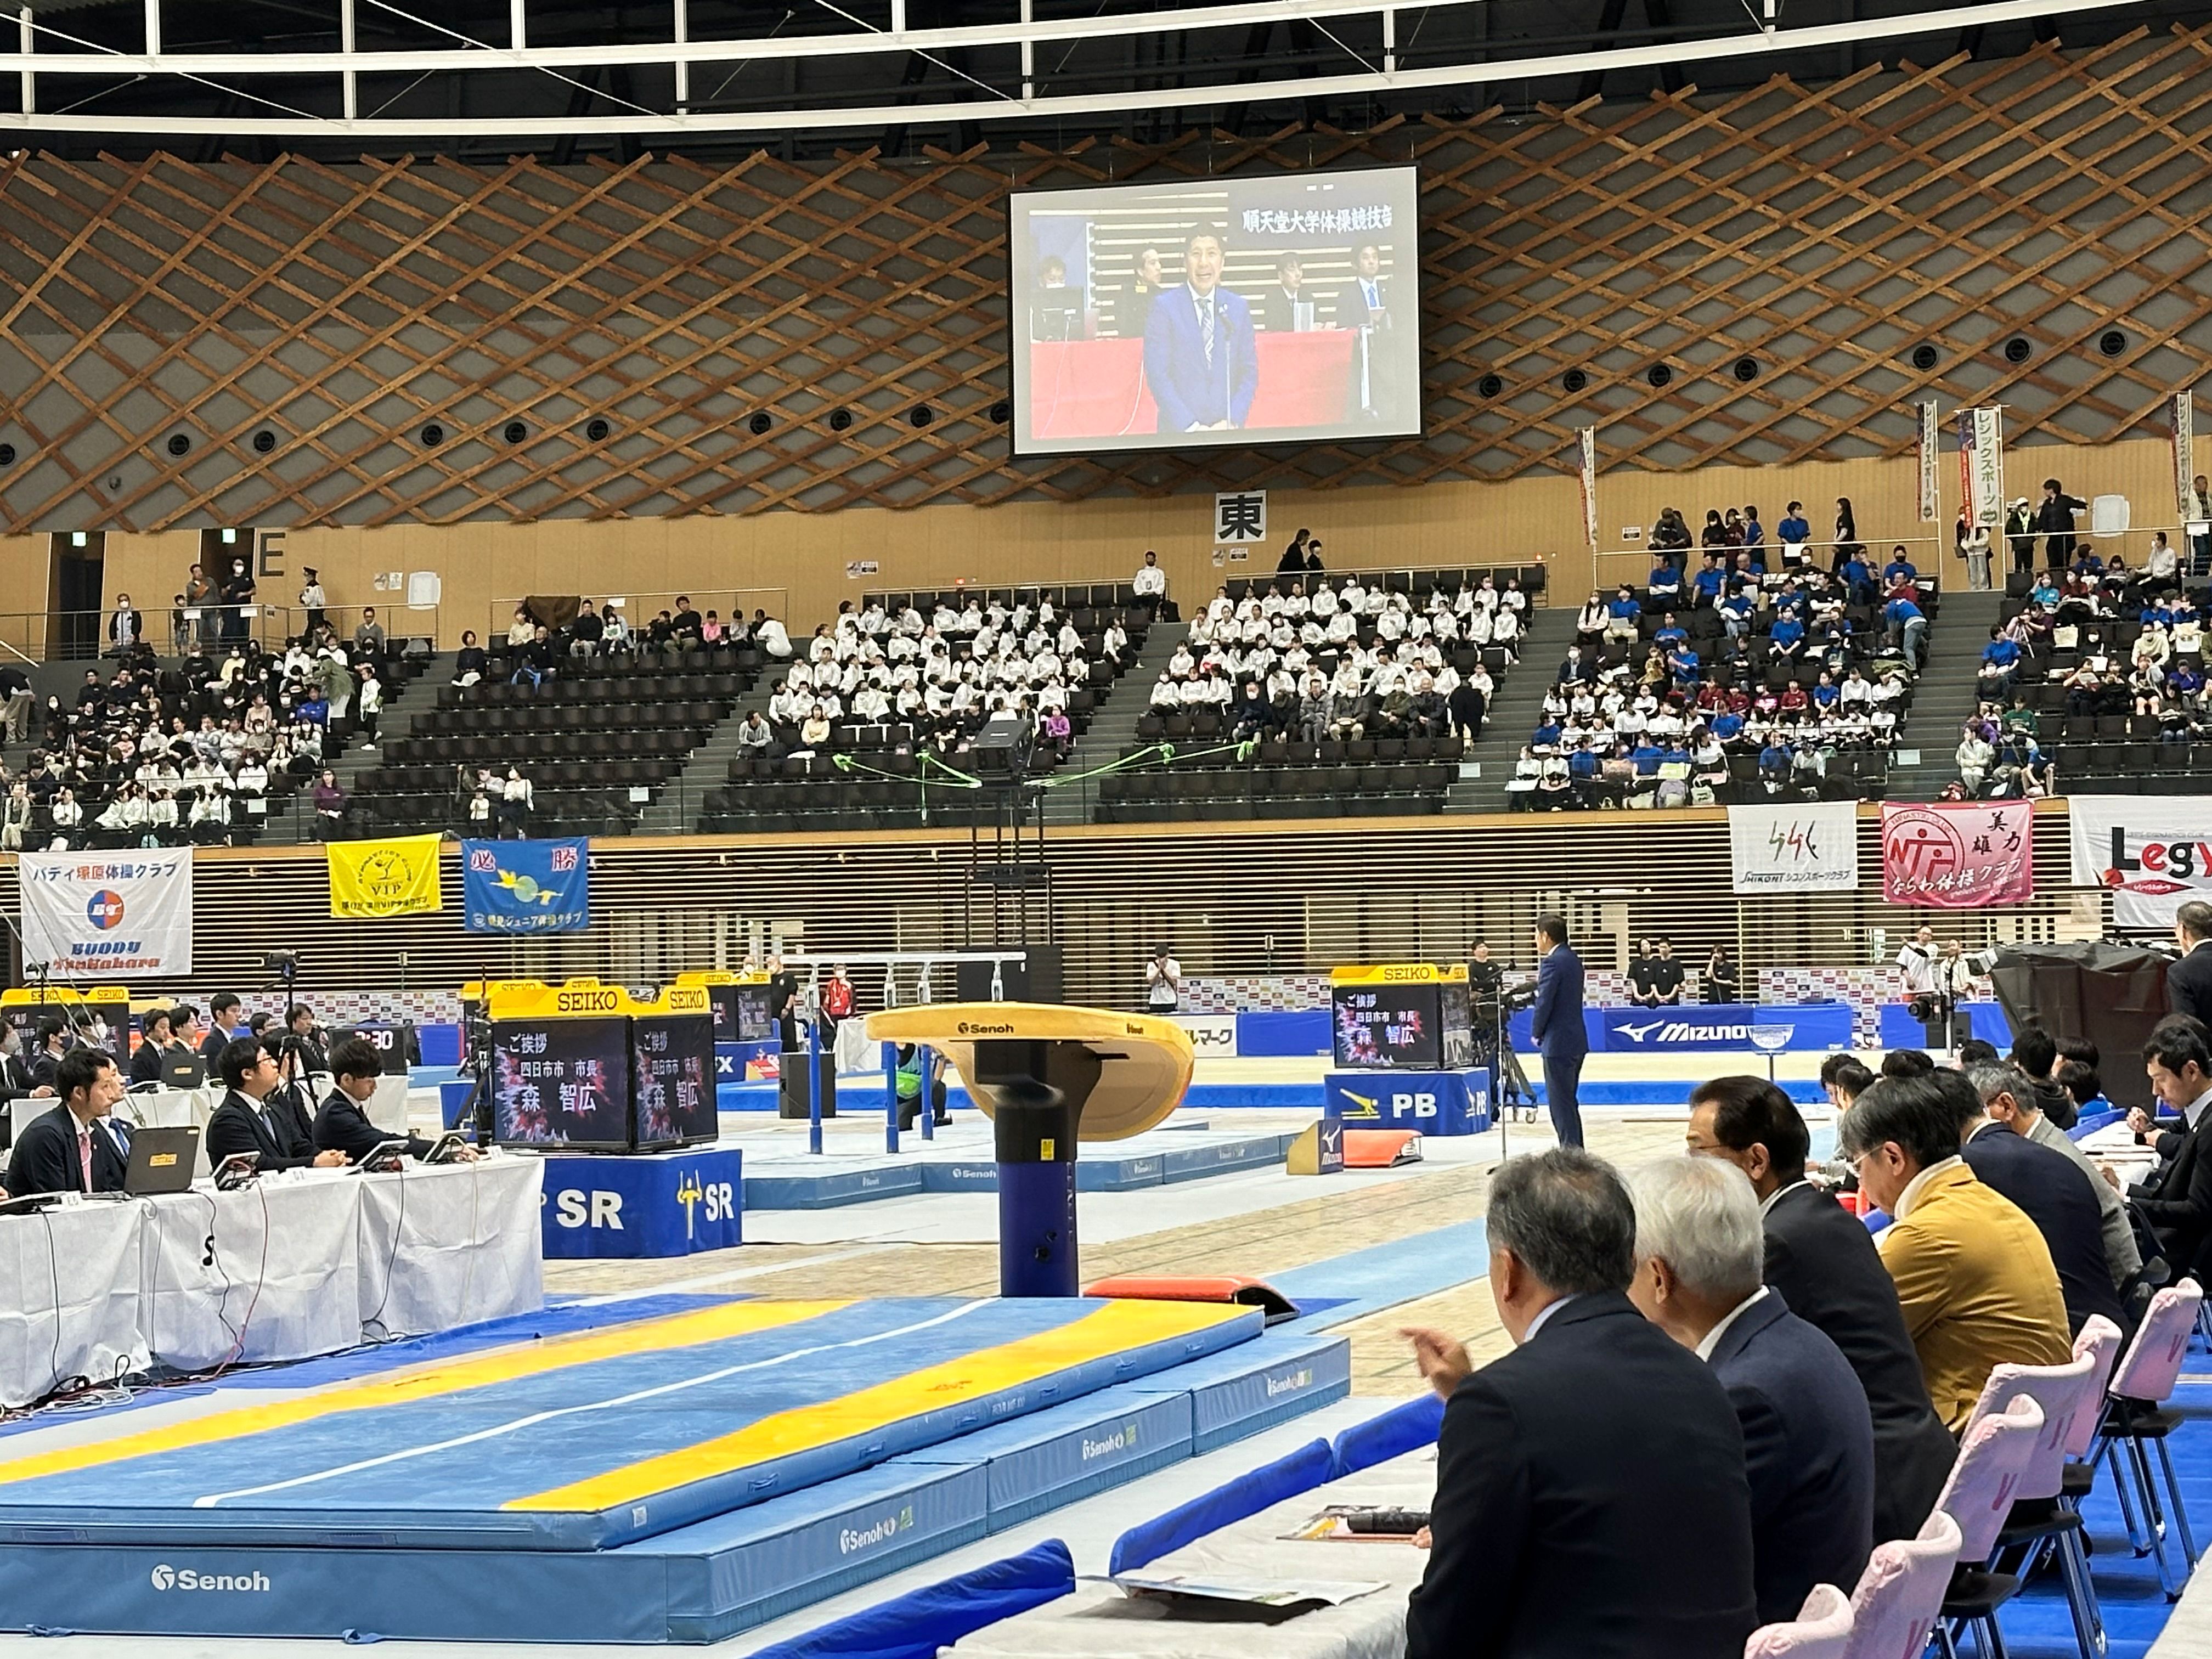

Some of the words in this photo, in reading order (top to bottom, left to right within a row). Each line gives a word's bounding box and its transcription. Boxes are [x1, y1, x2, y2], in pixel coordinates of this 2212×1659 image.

[1978, 413, 1996, 505] レジックスポーツ
[1217, 494, 1263, 540] 東
[259, 532, 286, 577] E
[470, 849, 496, 872] 必
[551, 847, 579, 872] 勝
[33, 862, 178, 881] バディ塚原体操クラブ
[371, 883, 401, 896] VIP
[1384, 967, 1430, 980] SEIKO
[97, 989, 125, 1000] SEIKO
[557, 991, 618, 1012] SEIKO
[669, 990, 704, 1009] SEIKO
[1356, 1011, 1390, 1023] 四日市市
[970, 1023, 1014, 1034] Senoh
[509, 1032, 548, 1054] ご挨拶
[521, 1060, 565, 1078] 四日市市
[574, 1059, 598, 1077] 市長
[651, 1059, 679, 1076] 四日市市
[715, 1056, 734, 1074] X
[521, 1082, 541, 1113] 森
[558, 1082, 597, 1113] 智広
[676, 1079, 699, 1108] 智広
[1392, 1093, 1437, 1118] PB
[556, 1188, 624, 1230] SR
[705, 1183, 735, 1221] SR
[850, 1521, 883, 1550] Senoh
[178, 1570, 270, 1591] Senoh
